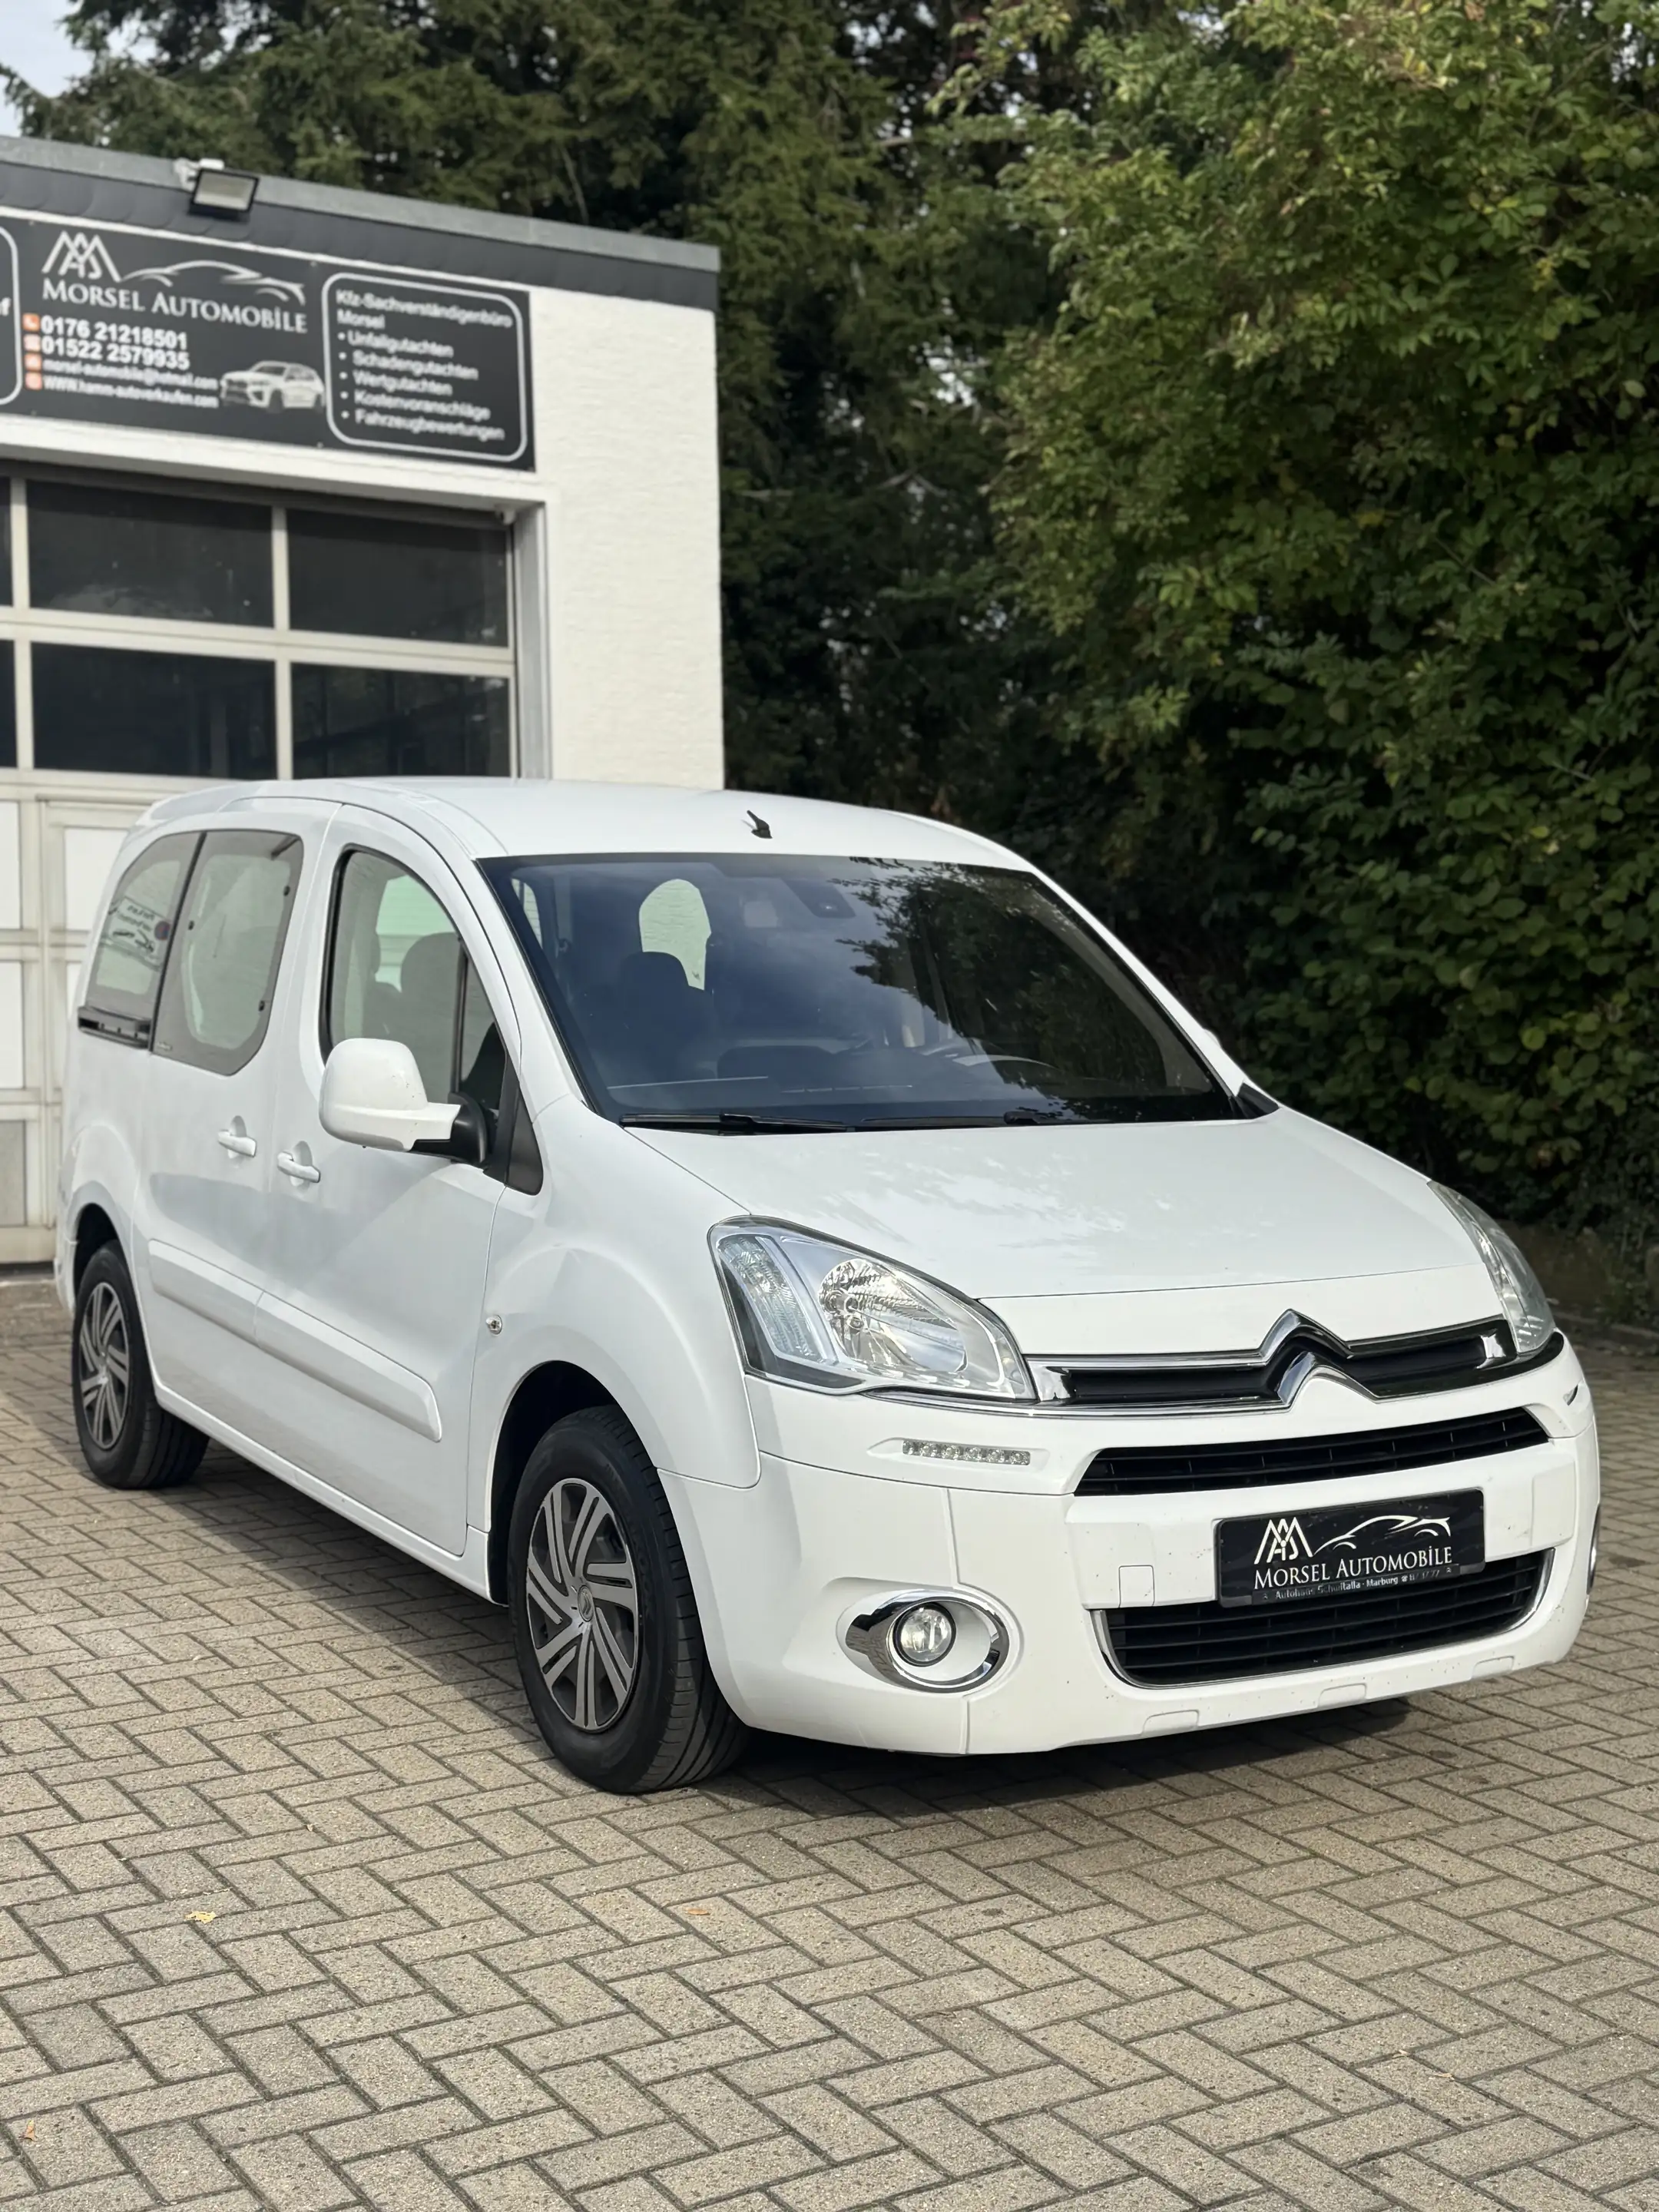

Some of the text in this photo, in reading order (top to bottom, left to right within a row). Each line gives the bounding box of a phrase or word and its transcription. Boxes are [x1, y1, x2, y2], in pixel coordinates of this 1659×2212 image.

[42, 277, 145, 311] MORSEL
[41, 315, 187, 349] 0176 21218501
[337, 309, 385, 329] Morsel
[41, 336, 190, 370] 01522 2579935
[348, 329, 454, 358] Unfallgutachten
[353, 349, 478, 380] Schadengutachten
[353, 369, 452, 396] Wertgutachten
[354, 389, 491, 422] Kostenvoranschläge
[355, 409, 505, 442] Fahrzeugbewertungen
[1254, 1563, 1330, 1589] MORSEL
[1366, 1577, 1399, 1587] Marburg
